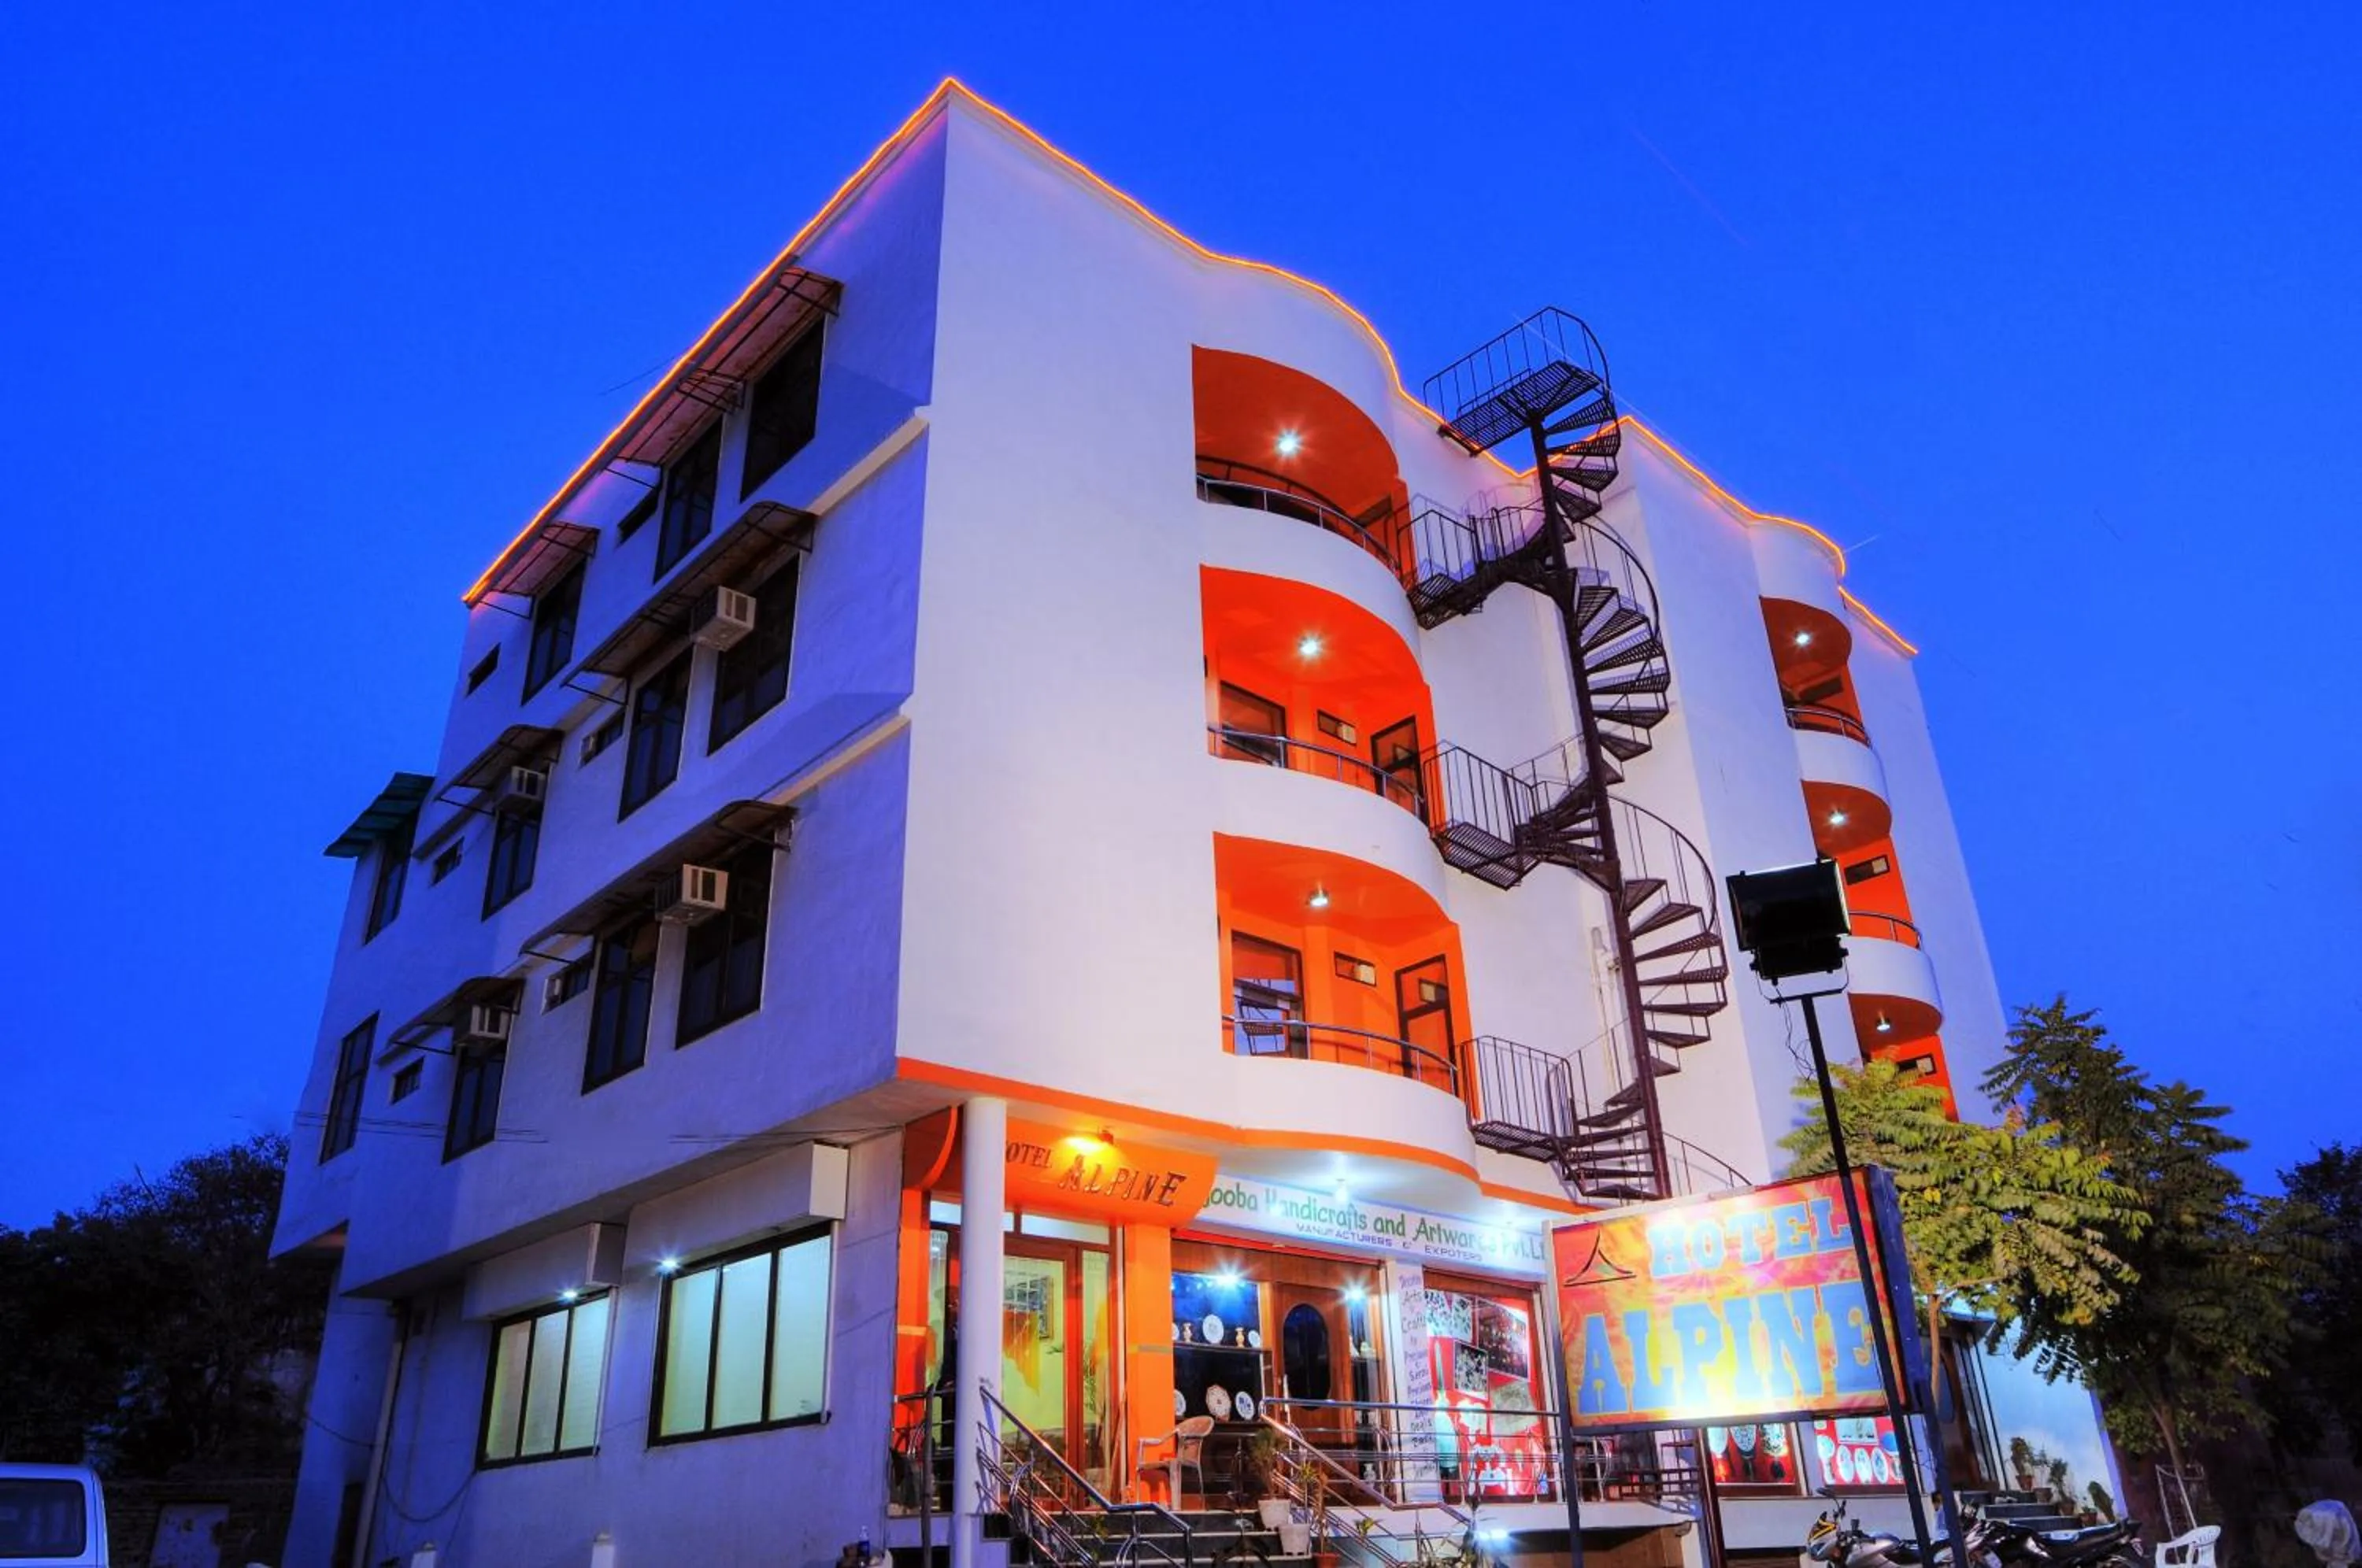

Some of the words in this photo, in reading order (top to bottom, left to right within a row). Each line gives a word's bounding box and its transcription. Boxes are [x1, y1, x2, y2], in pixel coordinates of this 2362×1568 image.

[1006, 1142, 1053, 1168] OTEL
[1058, 1152, 1187, 1207] ALPINE
[1373, 1212, 1406, 1237] and
[1649, 1198, 1853, 1277] HOTEL
[1579, 1281, 1881, 1414] ALPINE
